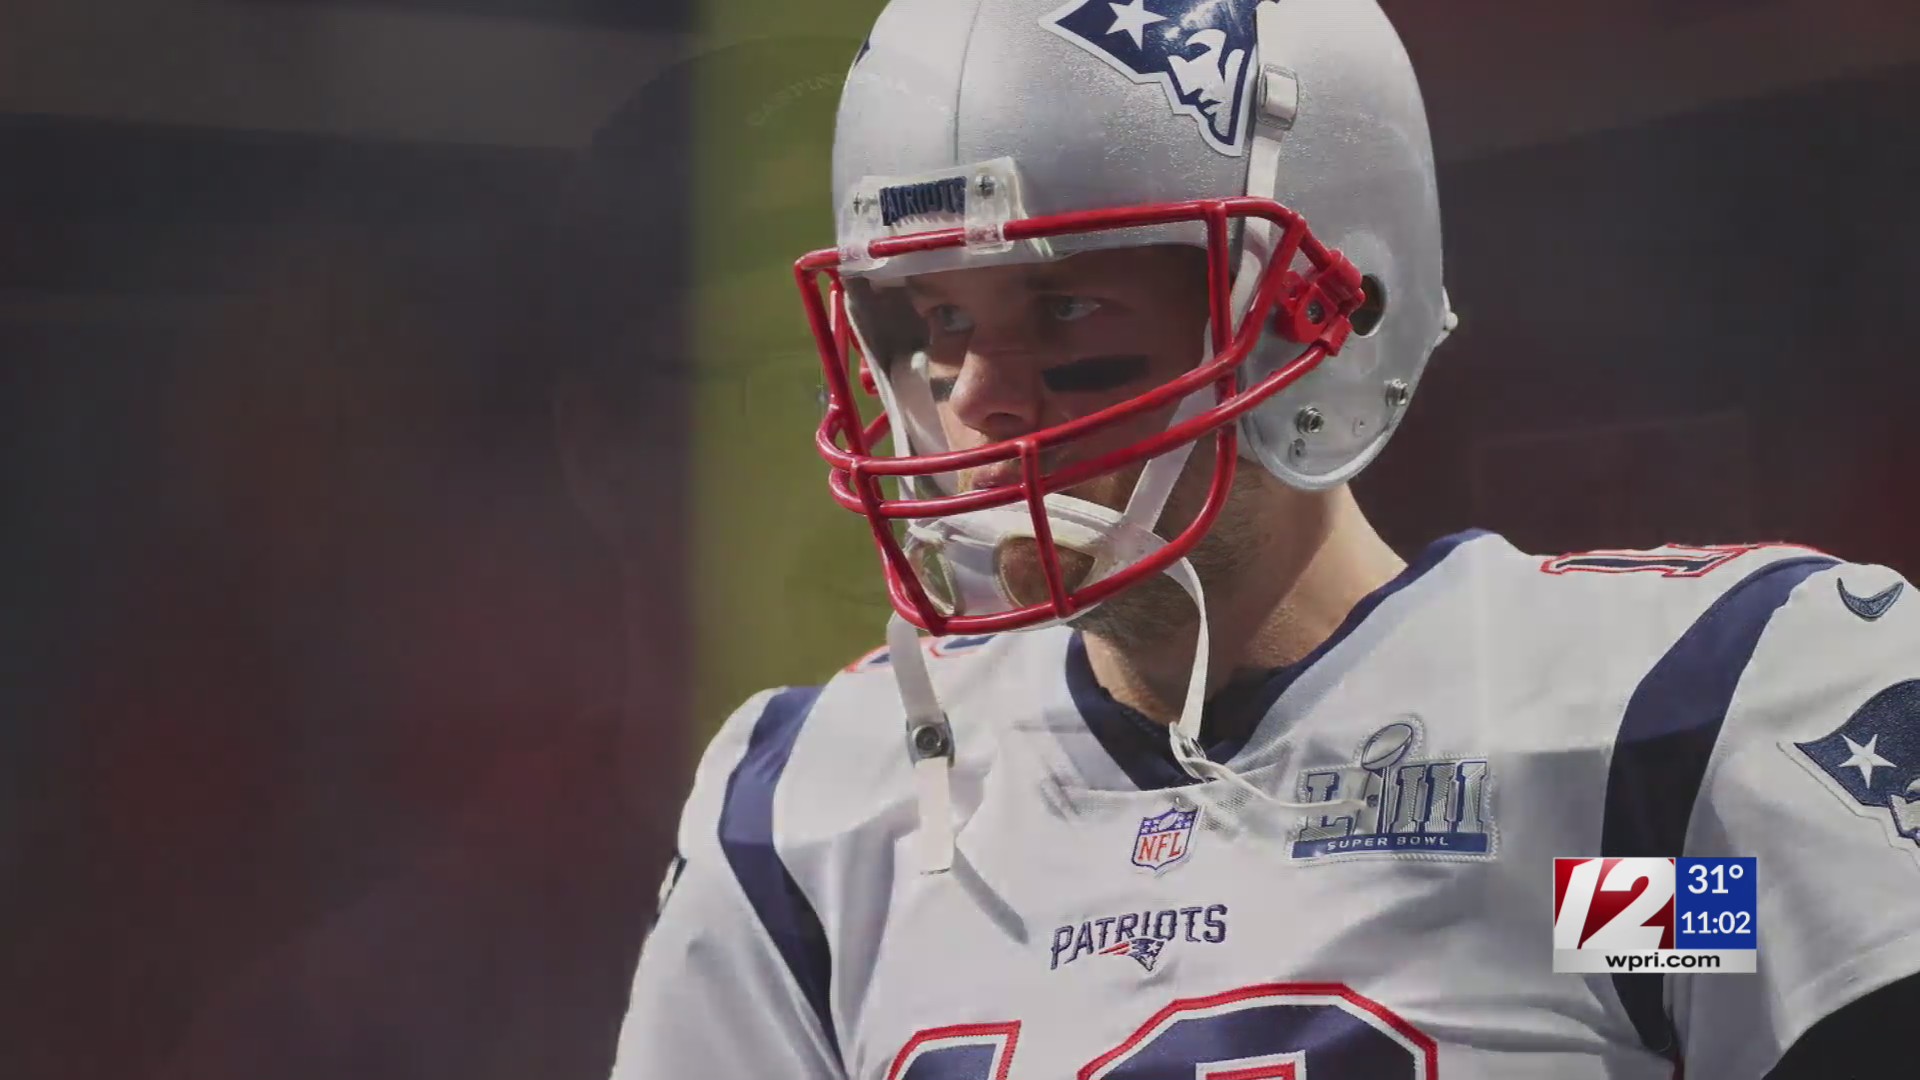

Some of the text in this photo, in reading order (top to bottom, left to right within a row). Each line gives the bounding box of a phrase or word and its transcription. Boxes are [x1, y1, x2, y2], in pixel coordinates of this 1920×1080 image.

[1137, 830, 1182, 861] NFL
[1327, 835, 1449, 851] SUPER BOWL
[1050, 903, 1228, 970] PATRIOTS
